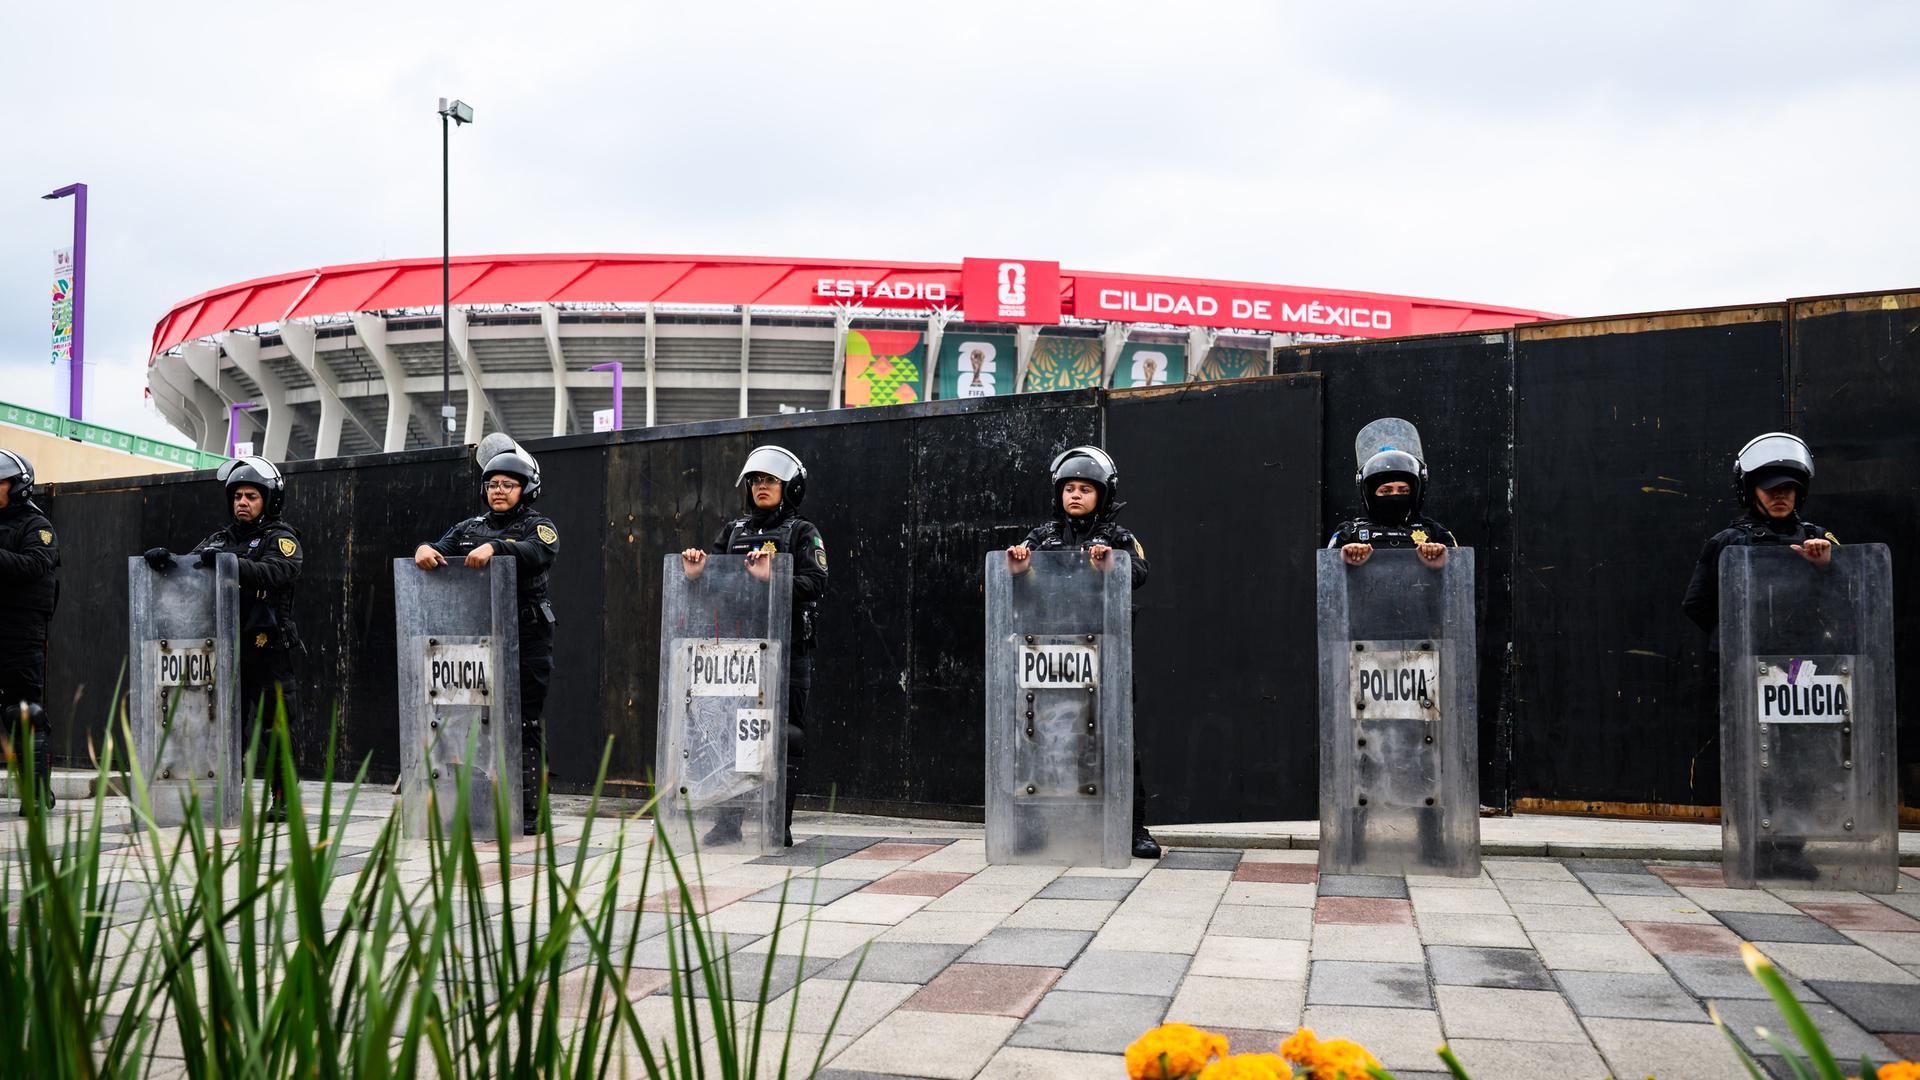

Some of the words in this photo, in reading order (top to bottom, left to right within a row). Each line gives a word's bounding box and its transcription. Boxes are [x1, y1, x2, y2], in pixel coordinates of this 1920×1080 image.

[817, 278, 946, 301] ESTADIO
[1099, 289, 1218, 316] CIUDAD
[1232, 298, 1271, 321] DE
[1282, 300, 1391, 330] MÉXICO
[161, 654, 212, 682] POLICIA
[432, 661, 487, 689] POLICIA
[694, 655, 757, 685] POLICIA
[1025, 652, 1093, 682] POLICIA
[1360, 668, 1428, 702] POLICIA
[1764, 684, 1848, 716] POLICIA
[738, 718, 771, 741] SSP
